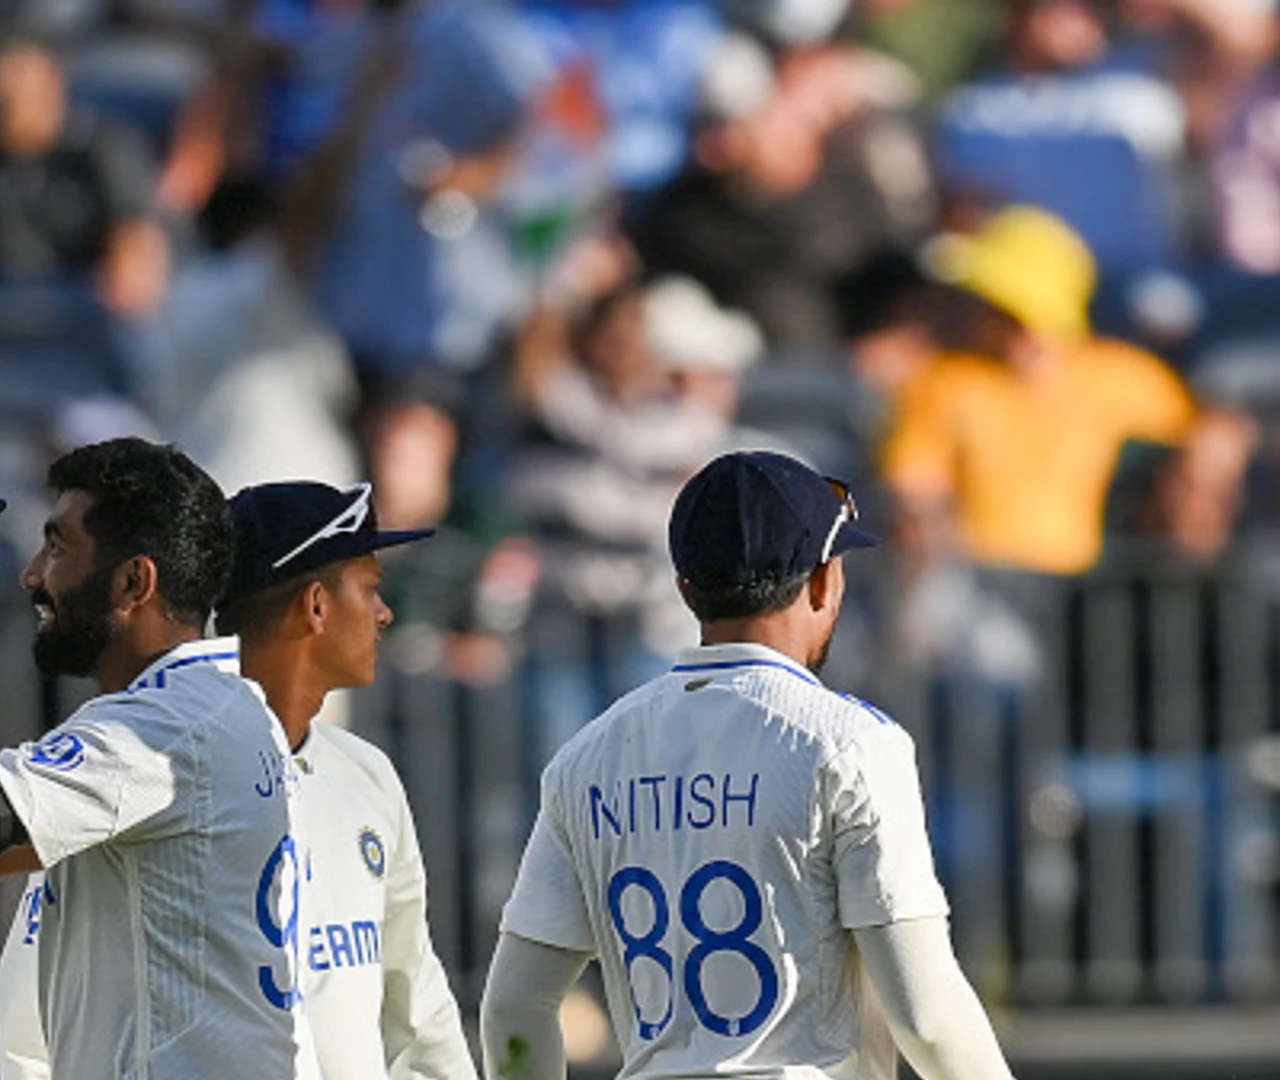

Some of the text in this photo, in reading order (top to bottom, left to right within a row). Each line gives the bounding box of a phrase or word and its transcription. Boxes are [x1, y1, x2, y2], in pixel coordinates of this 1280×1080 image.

[588, 773, 760, 840] NITISH
[307, 919, 384, 972] EAM
[607, 860, 779, 1041] 88
